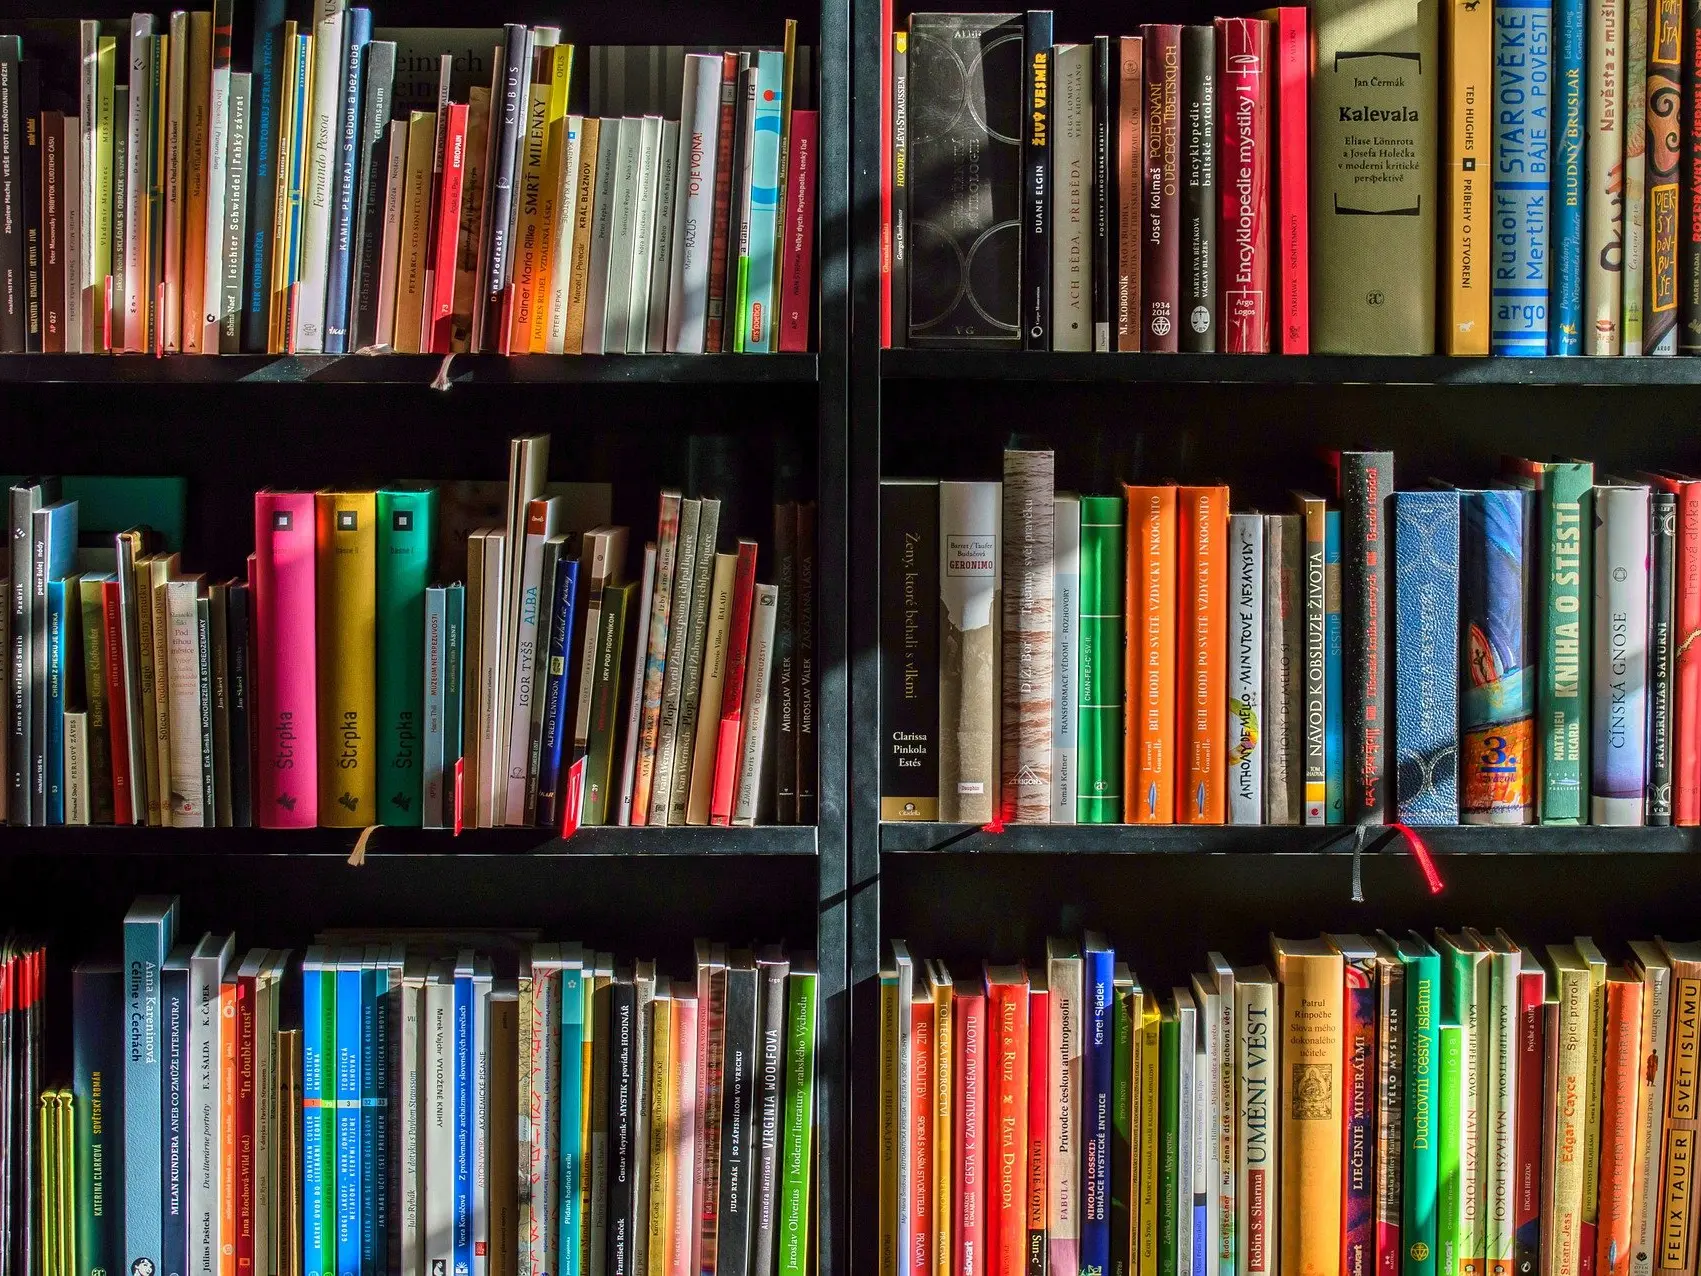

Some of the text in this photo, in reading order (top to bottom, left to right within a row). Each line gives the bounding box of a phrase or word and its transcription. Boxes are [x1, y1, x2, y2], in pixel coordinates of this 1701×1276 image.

[348, 44, 359, 69] teba
[347, 73, 358, 92] bez
[1354, 77, 1404, 88] Jan Čermák
[1466, 85, 1474, 105] TED
[1497, 14, 1525, 173] STAROVĚKÉ
[1527, 14, 1548, 173] BÁJE A POVĚSTI
[1, 88, 9, 132] ZDAŇOVANIU
[345, 107, 356, 140] tebou
[1201, 75, 1213, 186] baltské mytologie
[1236, 96, 1254, 163] mystiky
[1339, 106, 1418, 122] Kalevala
[1465, 108, 1473, 150] HUGHES
[2, 134, 10, 153] PROTI
[691, 132, 703, 168] VOJNA!
[1031, 53, 1047, 233] DUANE ELGIN ŽIVÝ VESMÍR
[1164, 126, 1176, 181] VĚCECH
[1189, 102, 1200, 186] Encyklopedie
[1345, 137, 1413, 146] Eliase Lönnrota
[1350, 149, 1376, 158] Josefa
[1379, 149, 1415, 157] Holečka
[1563, 68, 1579, 207] BLUDNÝ BRUSLAŘ
[2, 155, 10, 177] VERŠE
[313, 115, 329, 208] Fernando Pessoa
[492, 230, 503, 274] Podracká
[505, 66, 518, 124] KUBUS
[690, 171, 702, 181] JE
[1149, 82, 1163, 245] Josef Kolmaš POJEDNÁNÍ
[1345, 161, 1382, 169] moderní
[1386, 161, 1419, 170] kritické
[1355, 174, 1403, 183] perspektivě
[4, 181, 12, 204] Machej
[341, 162, 352, 210] PETERAJ
[689, 184, 699, 197] TO
[1164, 185, 1175, 196] O
[4, 205, 12, 234] Zbigniew
[339, 216, 349, 250] KAMIL
[518, 98, 546, 323] Rainer Maria Rilke SMRŤ MILENKY
[684, 219, 697, 248] RÁZUS
[1236, 168, 1253, 282] Encyklopedie
[1464, 225, 1471, 233] O
[1497, 195, 1517, 280] Rudolf
[1526, 195, 1544, 280] Mertlík
[1462, 238, 1471, 288] STVORENÍ
[1497, 305, 1545, 328] argo
[35, 541, 44, 595] peter šulej nódy
[949, 561, 993, 569] GERONIMO
[1148, 496, 1160, 730] BŮH CHODÍ PO SVĚTĚ VŽDYCKY INKOGNITO
[1551, 502, 1579, 697] KNIHA O ŠTĚSTÍ
[519, 587, 538, 706] IGOR TYŠŠ ALBA
[1308, 552, 1322, 756] NÁVOD K OBSLUZE ŽIVOTA
[781, 657, 791, 684] VÁLEK
[1609, 612, 1627, 748] ČÍNSKÁ GNOSE
[547, 680, 559, 747] ALFRED TENNYSON
[781, 687, 791, 732] MIROSLAV
[273, 712, 297, 769] Štrpka
[337, 712, 361, 768] Štrpka
[392, 712, 416, 768] Štrpka
[893, 731, 927, 741] Clarissa
[893, 744, 927, 754] Pinkola
[1554, 711, 1564, 760] MATTHIEU
[1569, 722, 1579, 760] RICARD
[899, 757, 922, 766] Estés
[171, 997, 179, 1057] LITERATURA?
[1059, 999, 1071, 1067] anthroposofií
[1094, 983, 1105, 1045] Karel Sládek
[1413, 980, 1431, 1149] Duchovní cesty islámu
[1675, 986, 1696, 1112] SVĚT ISLÁMU
[170, 1059, 179, 1093] ZMŮŽE
[172, 1094, 179, 1105] CO
[1059, 1069, 1069, 1103] českou
[787, 997, 807, 1270] Jaroslav Oliverius Moderní literatury arabského Východu
[1059, 1106, 1069, 1152] Průvodce
[1241, 1004, 1268, 1267] Robin S. Sharma UMĚNÍ VÉST
[1351, 1036, 1365, 1189] LIEČENIE MINERÁLMI
[92, 1072, 102, 1216] KATERINA CLARKOVÁ SOVĚTSKÝ ROMÁN
[171, 1136, 179, 1181] KUNDERA
[1096, 1133, 1106, 1178] MYSTICKÉ
[171, 1183, 179, 1215] MILAN
[1088, 1139, 1096, 1219] NIKOLAJ LOSSKIJ:
[1095, 1180, 1105, 1220] OBHÁJCE
[1668, 1138, 1687, 1260] FELIX TAUER
